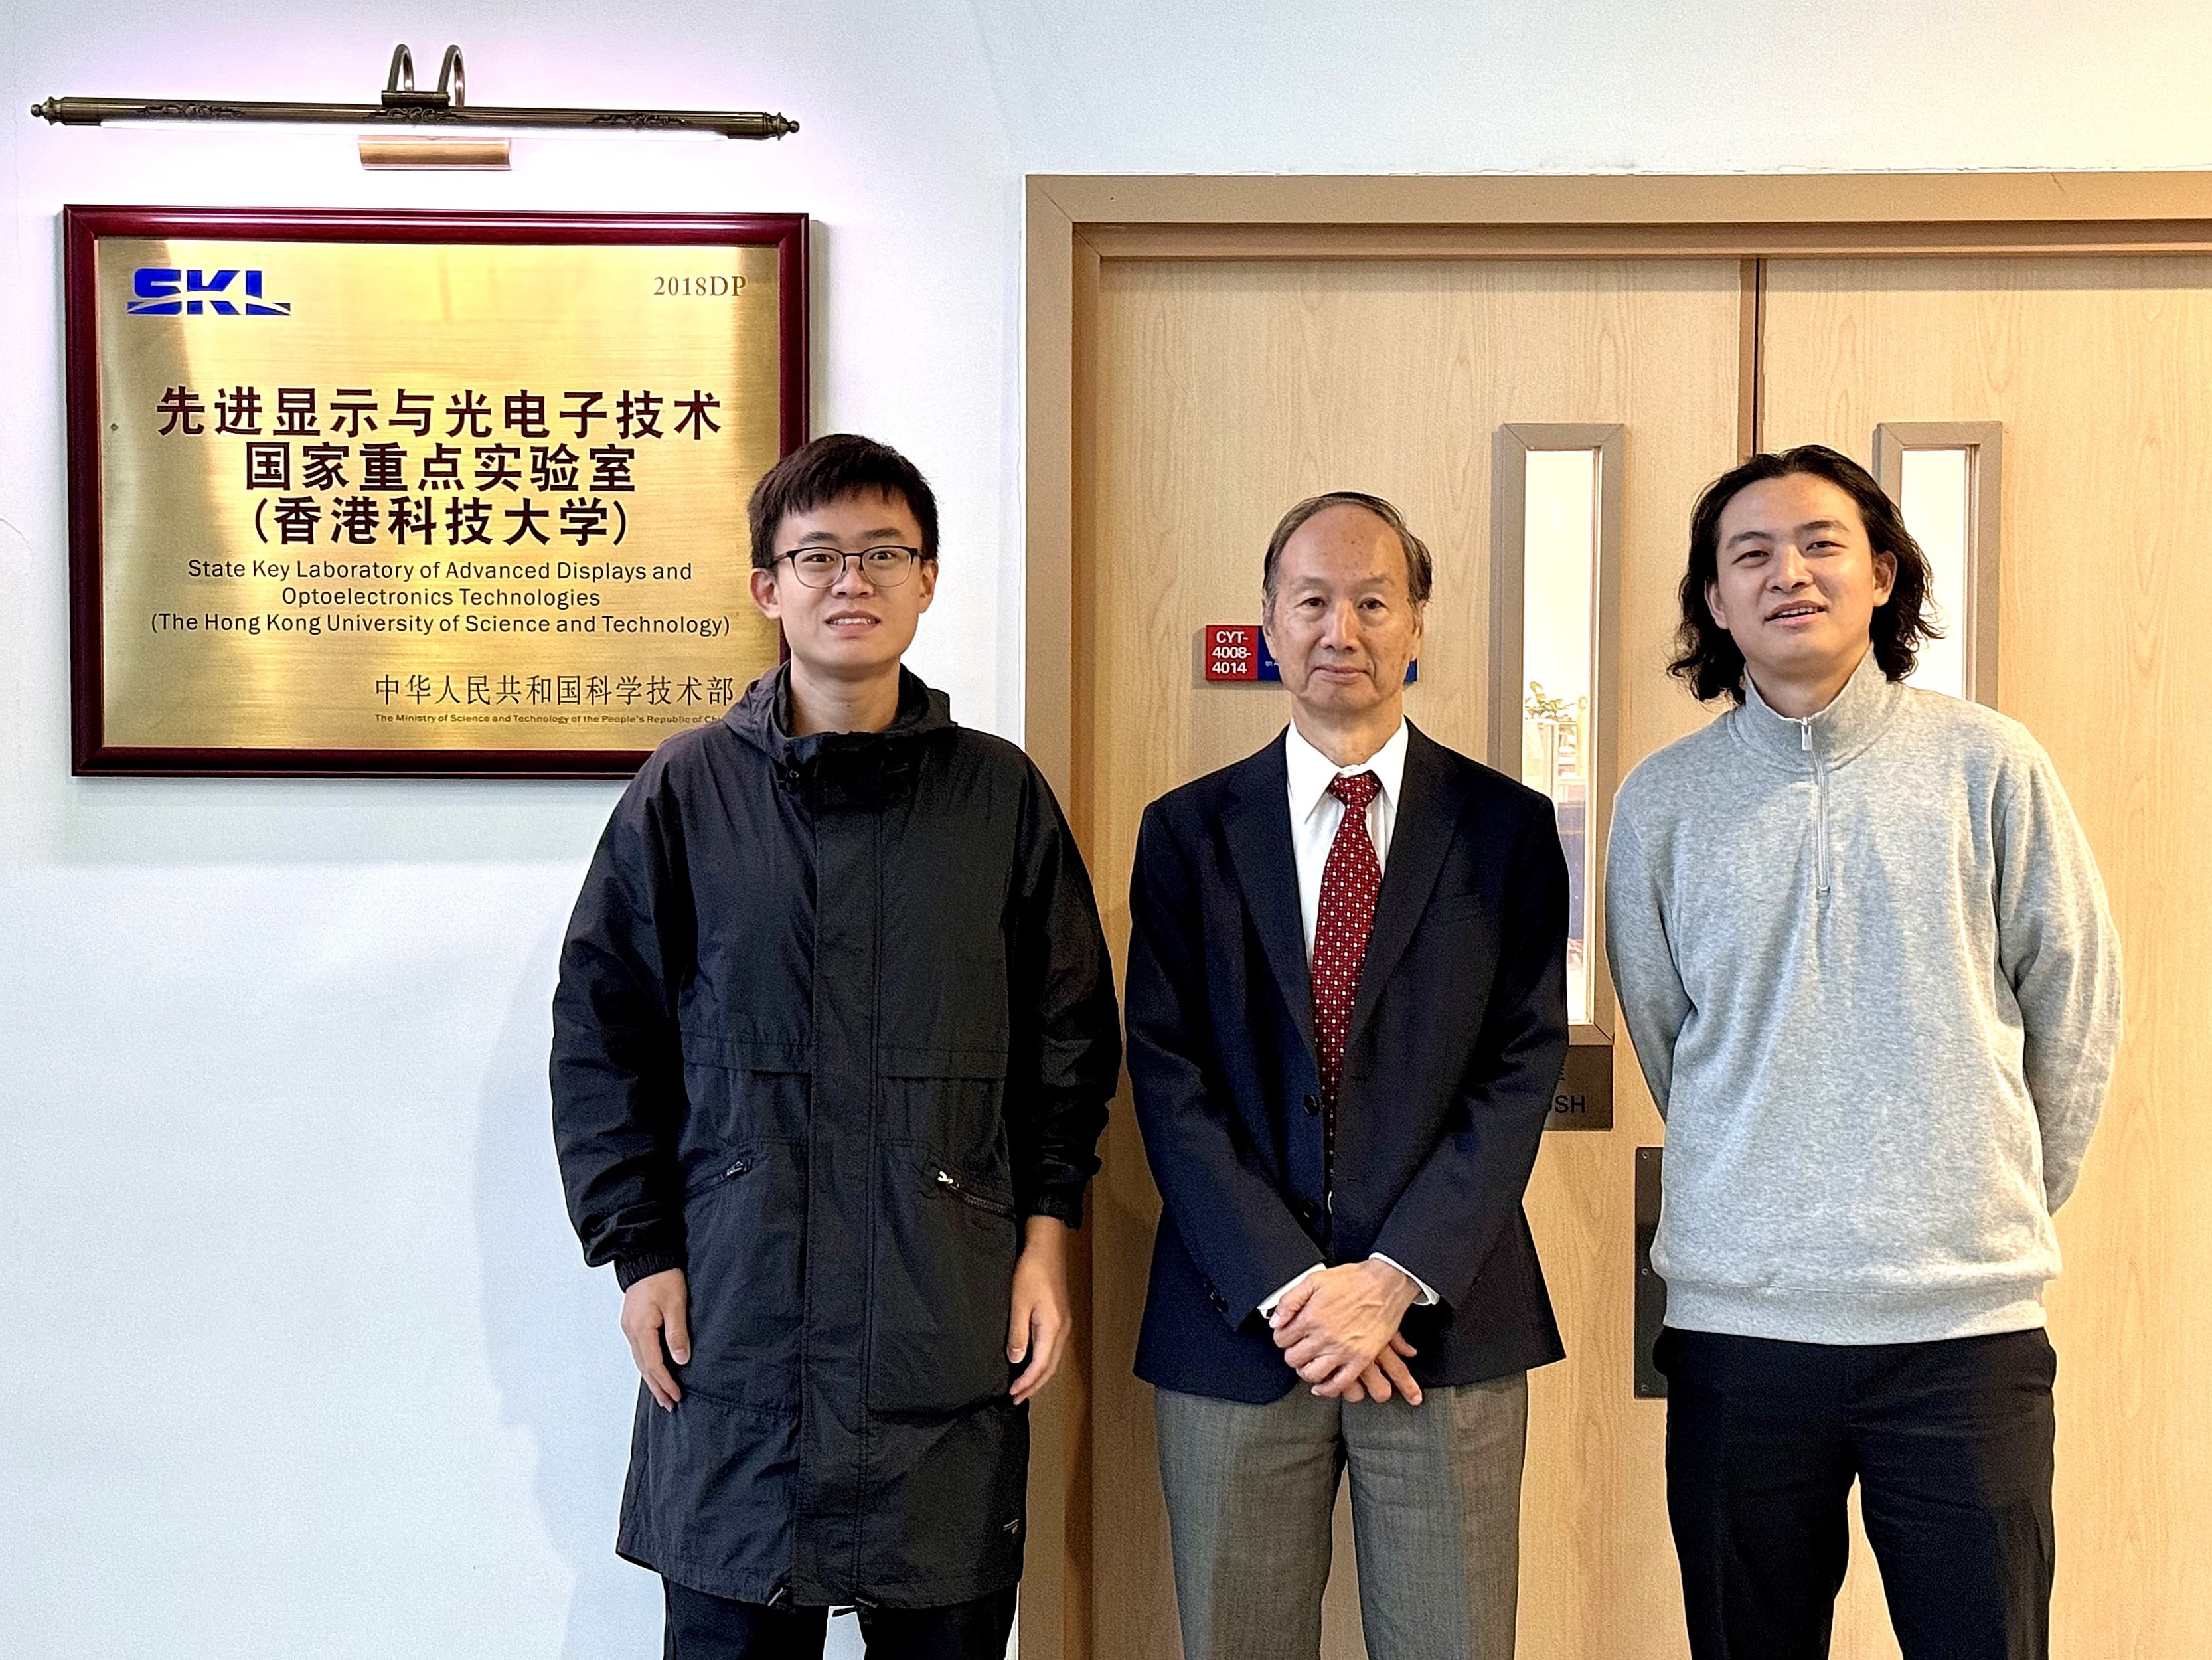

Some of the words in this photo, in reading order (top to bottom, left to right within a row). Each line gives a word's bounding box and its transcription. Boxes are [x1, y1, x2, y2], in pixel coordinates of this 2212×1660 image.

[126, 268, 291, 315] SKL
[653, 276, 747, 297] 2018DP
[157, 385, 721, 441] 先进显示与光电子技术
[246, 441, 636, 493] 国家重点实验室
[188, 559, 246, 578] State
[252, 560, 291, 582] Key
[297, 560, 414, 582] Laboratory
[420, 561, 441, 579] of
[446, 562, 550, 580] Advanced
[557, 562, 647, 584] Displays
[653, 562, 692, 580] and
[282, 587, 453, 608] Optoelectronics
[459, 588, 601, 610] Technologies
[151, 612, 198, 635] (The
[205, 614, 261, 635] Hong
[267, 614, 322, 636] Kong
[327, 614, 434, 636] University
[439, 615, 461, 633] of
[465, 615, 550, 633] Science
[556, 615, 595, 633] and
[601, 616, 730, 637] Technology)
[1216, 631, 1249, 644] CYT-
[1212, 647, 1252, 659] 4008-
[1212, 661, 1248, 674] 4014
[374, 673, 734, 706] 中华人民共和国科学技术部
[375, 713, 394, 722] The
[396, 714, 437, 724] Ministry
[438, 714, 449, 722] of
[513, 715, 569, 725] Technology
[647, 716, 691, 725] Republic
[1554, 1094, 1586, 1114] SH
